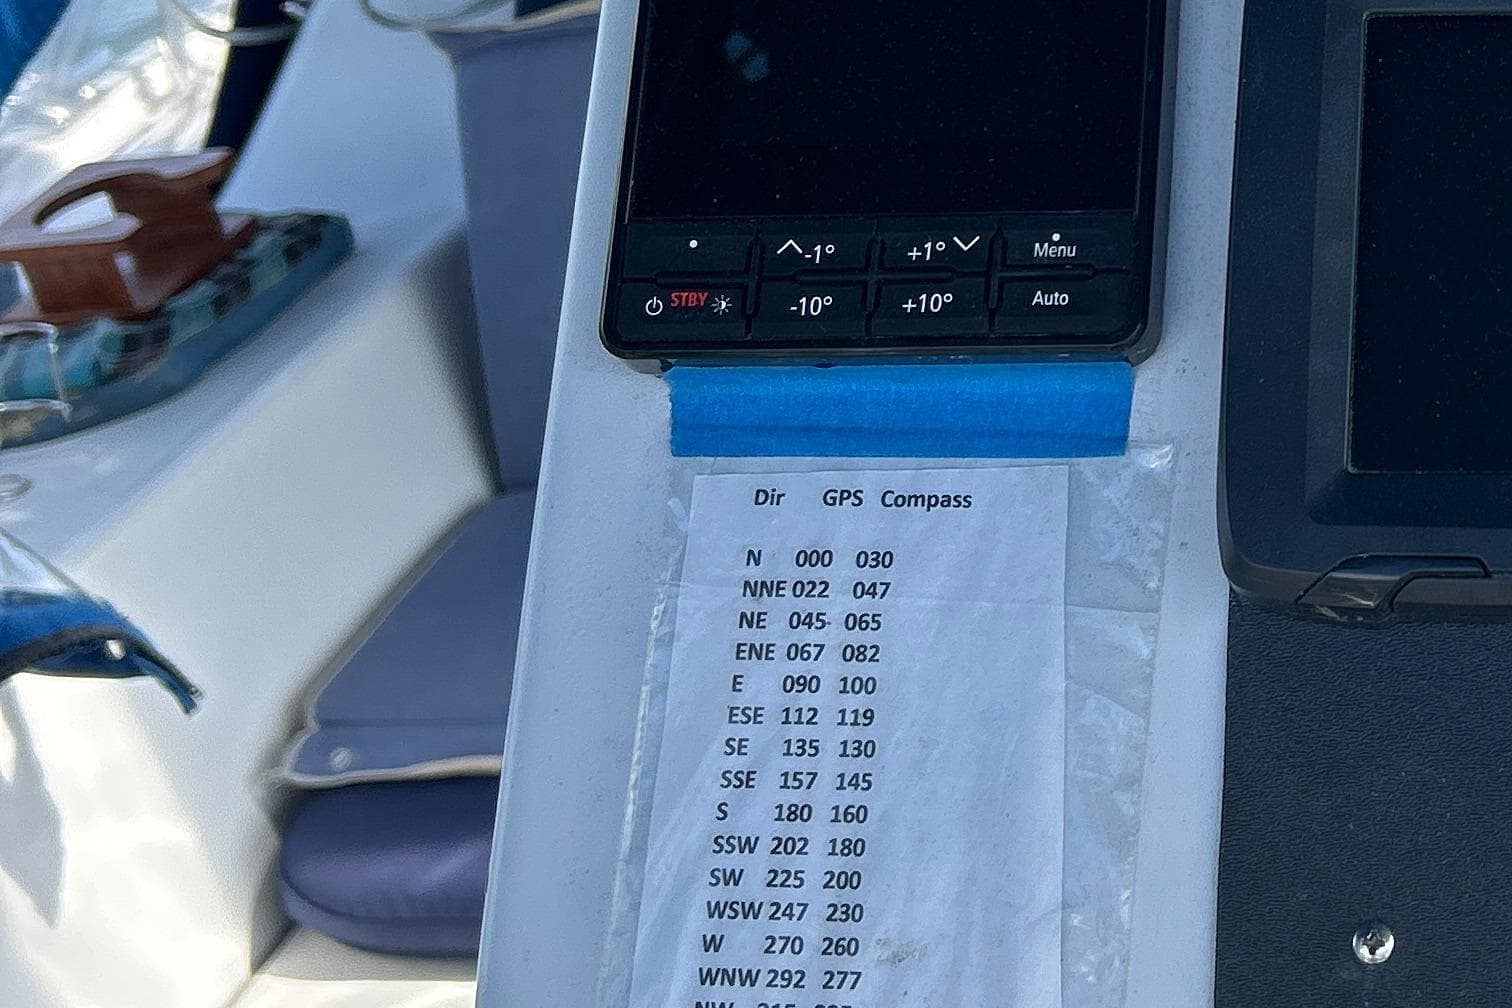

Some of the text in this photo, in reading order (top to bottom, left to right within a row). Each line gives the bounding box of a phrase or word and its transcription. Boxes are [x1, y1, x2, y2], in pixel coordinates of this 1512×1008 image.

[1031, 242, 1078, 259] Menu
[671, 291, 708, 307] STBY
[1031, 290, 1069, 306] Auto
[754, 487, 973, 513] Dir GPS Compass
[745, 549, 894, 569] N 000 030
[742, 579, 892, 600] NNE 022 047
[738, 610, 882, 632] NE 045 065
[735, 642, 880, 663] ENE 067 082
[731, 674, 877, 696] E 090 100
[727, 706, 875, 727] ESE 112 119
[723, 737, 876, 759] SE 135 130
[719, 769, 873, 792] SSE 157 145
[715, 801, 868, 824] S 180 160
[712, 834, 866, 858] SSW 202 180
[708, 867, 862, 891] SW 225 200
[706, 900, 864, 923] WSW 247 230
[701, 933, 860, 957] W 270 260
[698, 967, 862, 990] WNW 292 277
